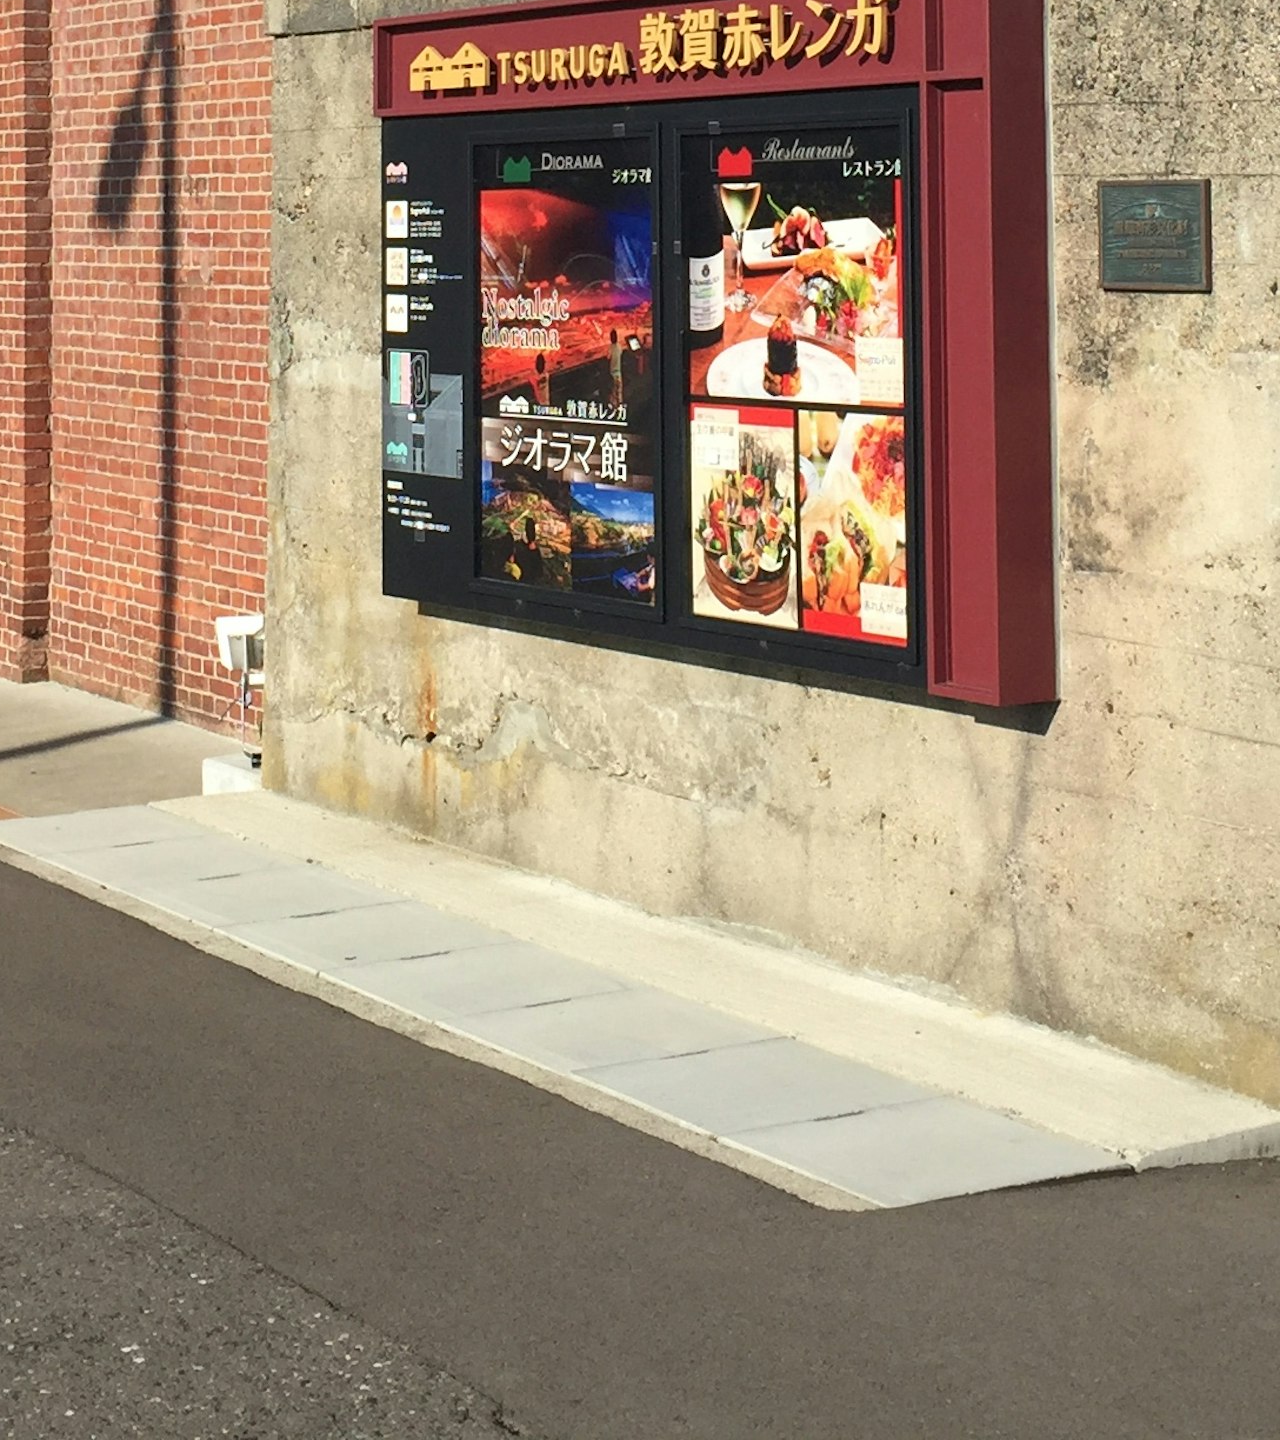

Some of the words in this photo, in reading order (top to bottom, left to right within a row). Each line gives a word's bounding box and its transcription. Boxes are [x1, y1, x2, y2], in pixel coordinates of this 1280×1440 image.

[497, 42, 628, 85] TSURUGA
[762, 136, 856, 161] Restaurants
[481, 287, 570, 327] Nostalgic
[482, 316, 561, 351] diorama
[566, 399, 628, 421] 敦賀赤レンガ
[500, 424, 628, 483] ジオラマ館
